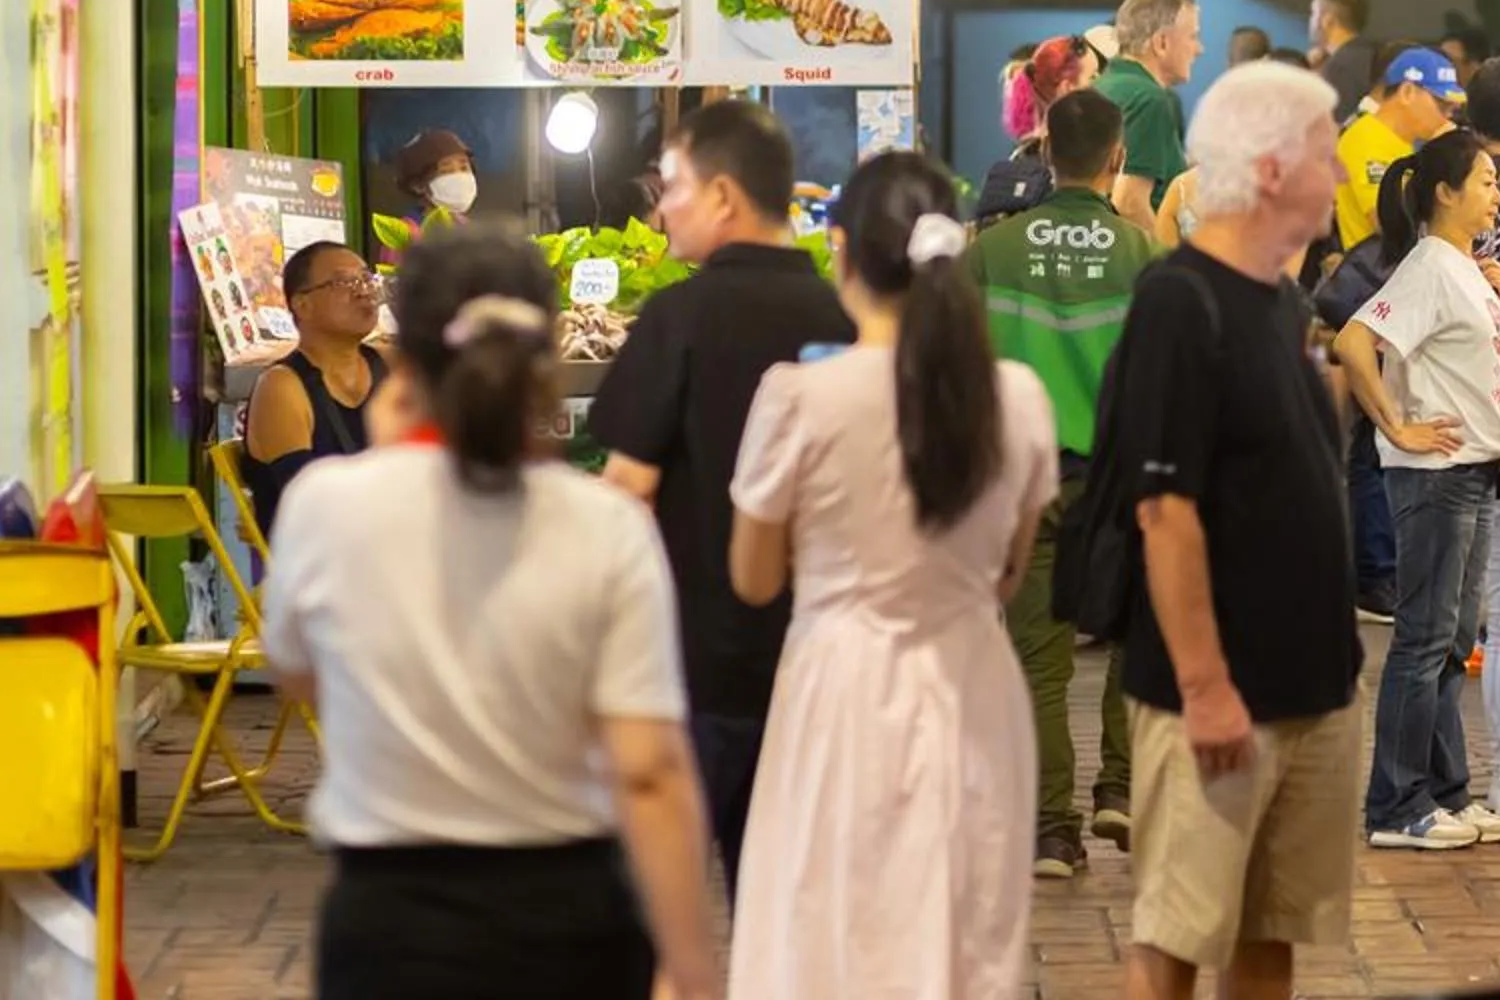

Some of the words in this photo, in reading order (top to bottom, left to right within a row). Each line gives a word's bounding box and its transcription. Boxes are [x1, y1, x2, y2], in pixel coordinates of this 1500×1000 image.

[355, 68, 394, 81] crab
[784, 66, 832, 81] Squid
[1026, 218, 1116, 250] Grab
